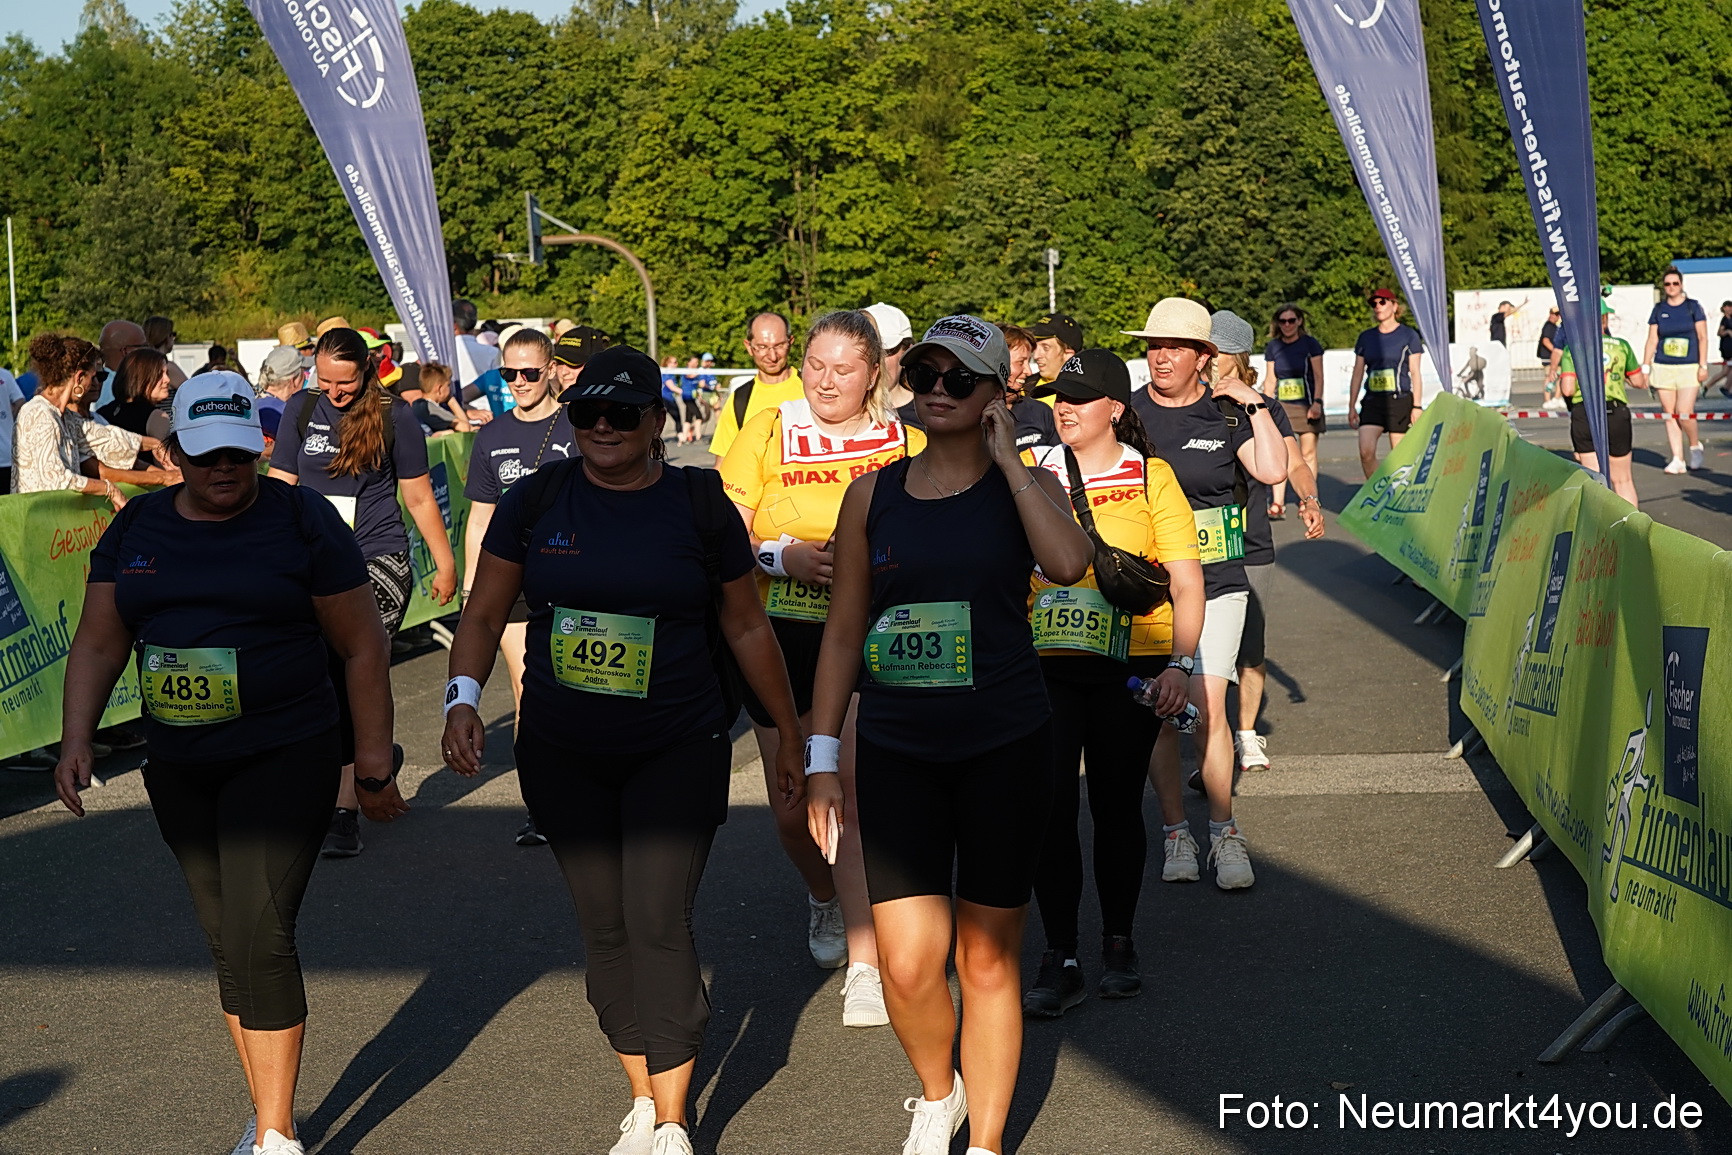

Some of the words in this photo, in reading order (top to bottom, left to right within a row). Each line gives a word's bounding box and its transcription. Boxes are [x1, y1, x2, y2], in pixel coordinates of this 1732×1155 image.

[613, 376, 633, 385] adidas
[195, 401, 240, 413] authentic
[781, 470, 842, 488] MAX
[50, 508, 108, 560] Gesunde
[548, 532, 576, 547] aha!
[1215, 529, 1224, 553] 2022
[129, 555, 155, 567] aha!
[771, 578, 782, 608] WALK
[778, 598, 807, 608] Kotzian
[575, 626, 608, 634] Firmenlauf
[889, 618, 921, 627] Firmenlauf
[1034, 612, 1043, 641] WALK
[1044, 608, 1100, 631] 1595
[1099, 617, 1108, 646] 2022
[1085, 632, 1099, 640] Zoe
[870, 643, 880, 672] RUN
[888, 632, 943, 660] 493
[955, 635, 967, 674] 2022
[556, 638, 564, 675] WALK
[572, 639, 627, 669] 492
[635, 649, 647, 686] 2022
[880, 663, 916, 671] Hofmann
[918, 662, 956, 670] Rebecca
[566, 664, 631, 678] Hofmann-Duroskova
[584, 675, 608, 684] Andrea
[2, 677, 43, 716] neumarkt
[145, 675, 155, 711] WALK
[160, 675, 211, 701] 483
[223, 679, 235, 712] 2022
[1669, 680, 1694, 712] Fischer
[154, 700, 193, 712] Stellwagen
[195, 702, 225, 710] Sabine
[1624, 878, 1678, 924] neumarkt
